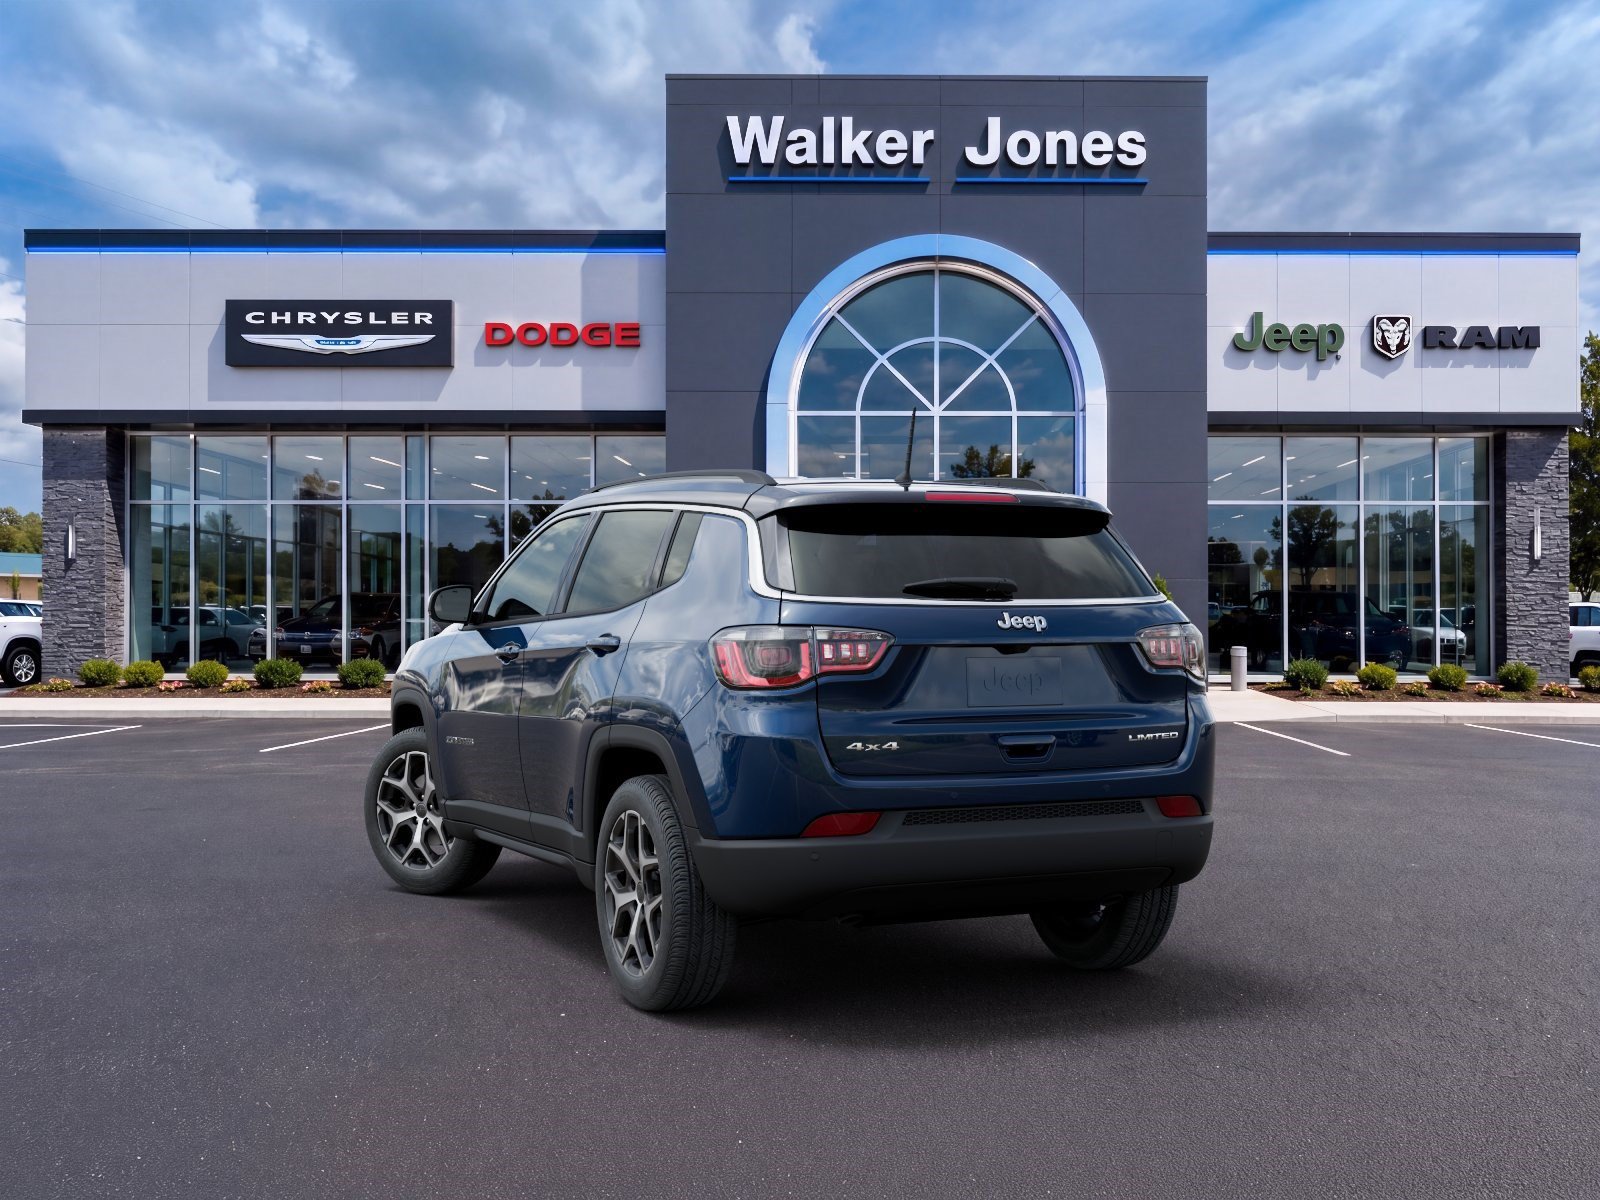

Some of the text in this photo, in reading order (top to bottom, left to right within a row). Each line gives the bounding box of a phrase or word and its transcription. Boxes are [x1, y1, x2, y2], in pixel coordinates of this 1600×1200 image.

[726, 115, 1147, 166] Walker Jones
[245, 311, 433, 325] CHRYSLER
[485, 322, 641, 347] DODGE
[1233, 311, 1344, 360] Jeep
[1423, 325, 1541, 348] RAM
[997, 611, 1048, 632] Jeep
[983, 666, 1043, 697] Jeep
[845, 741, 900, 752] 4x4
[1128, 731, 1179, 742] LIMITED
